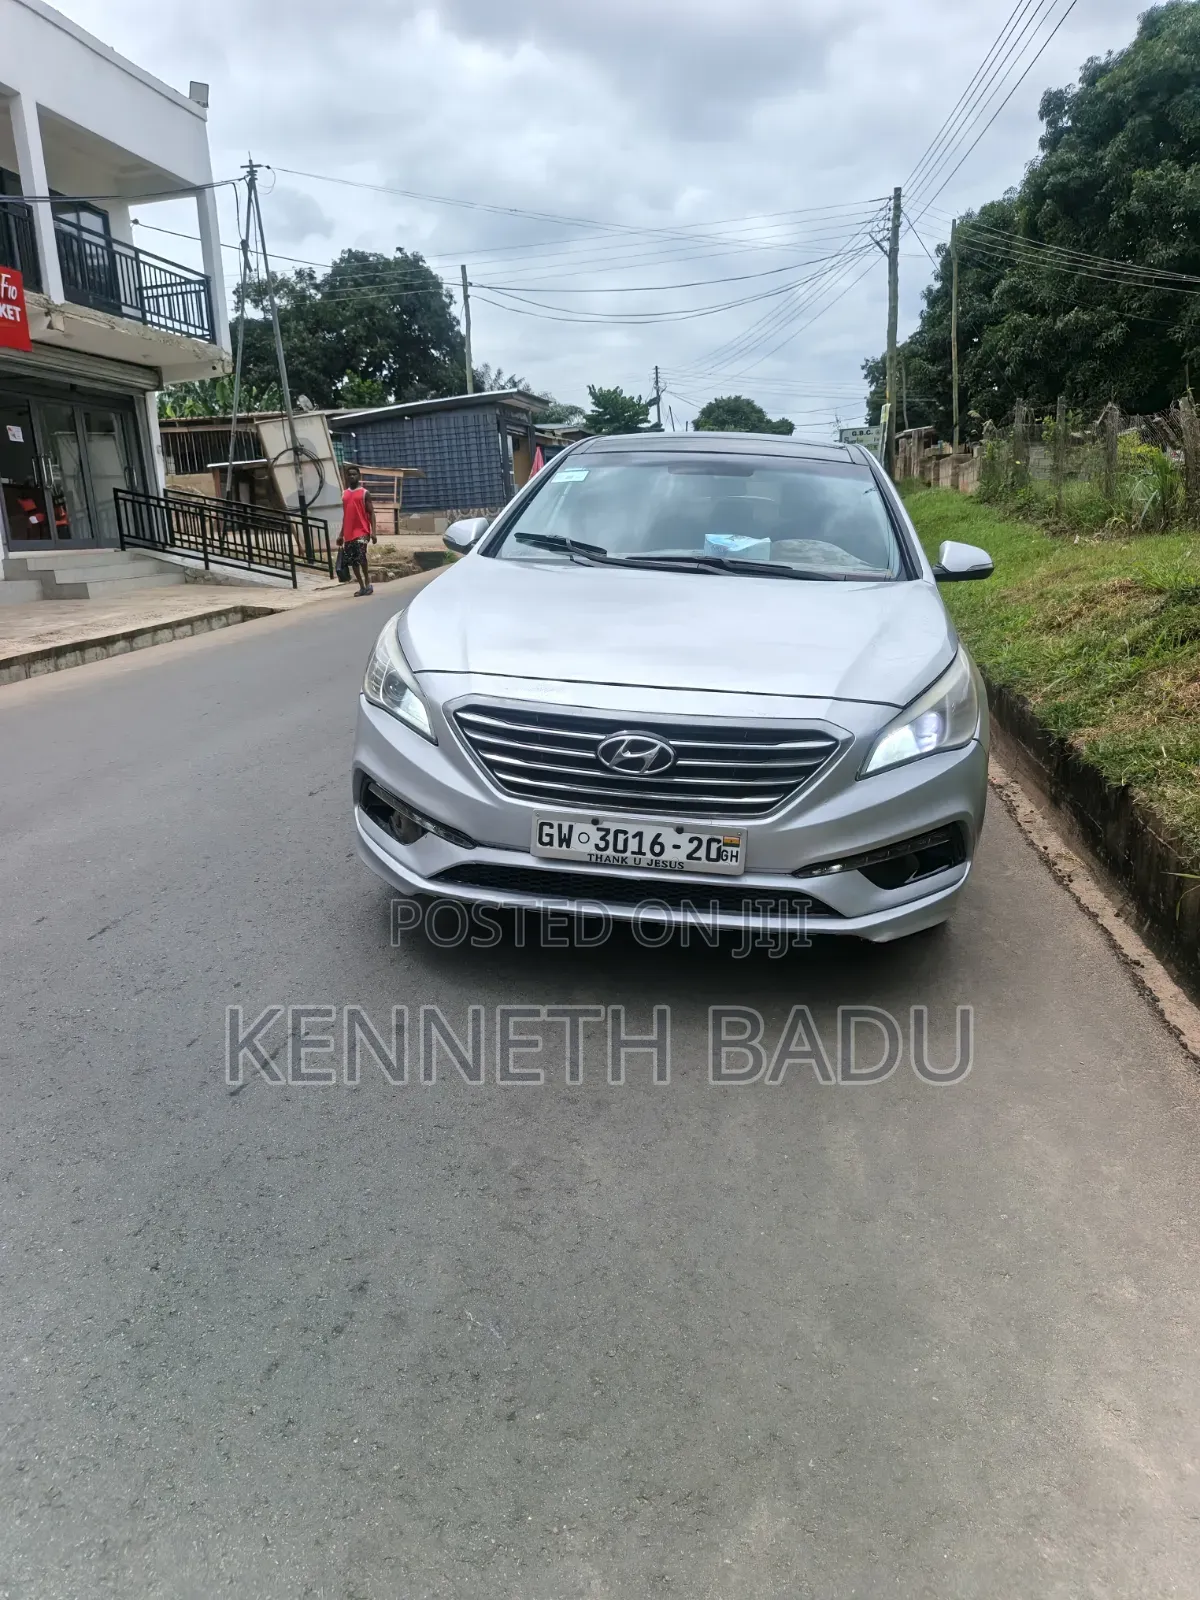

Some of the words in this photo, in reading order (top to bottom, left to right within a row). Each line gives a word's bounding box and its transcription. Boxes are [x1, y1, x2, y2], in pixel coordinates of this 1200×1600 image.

[538, 821, 574, 849] GW
[587, 853, 629, 865] THANK
[633, 857, 642, 866] U
[646, 858, 685, 870] JESUS
[720, 850, 739, 863] GH
